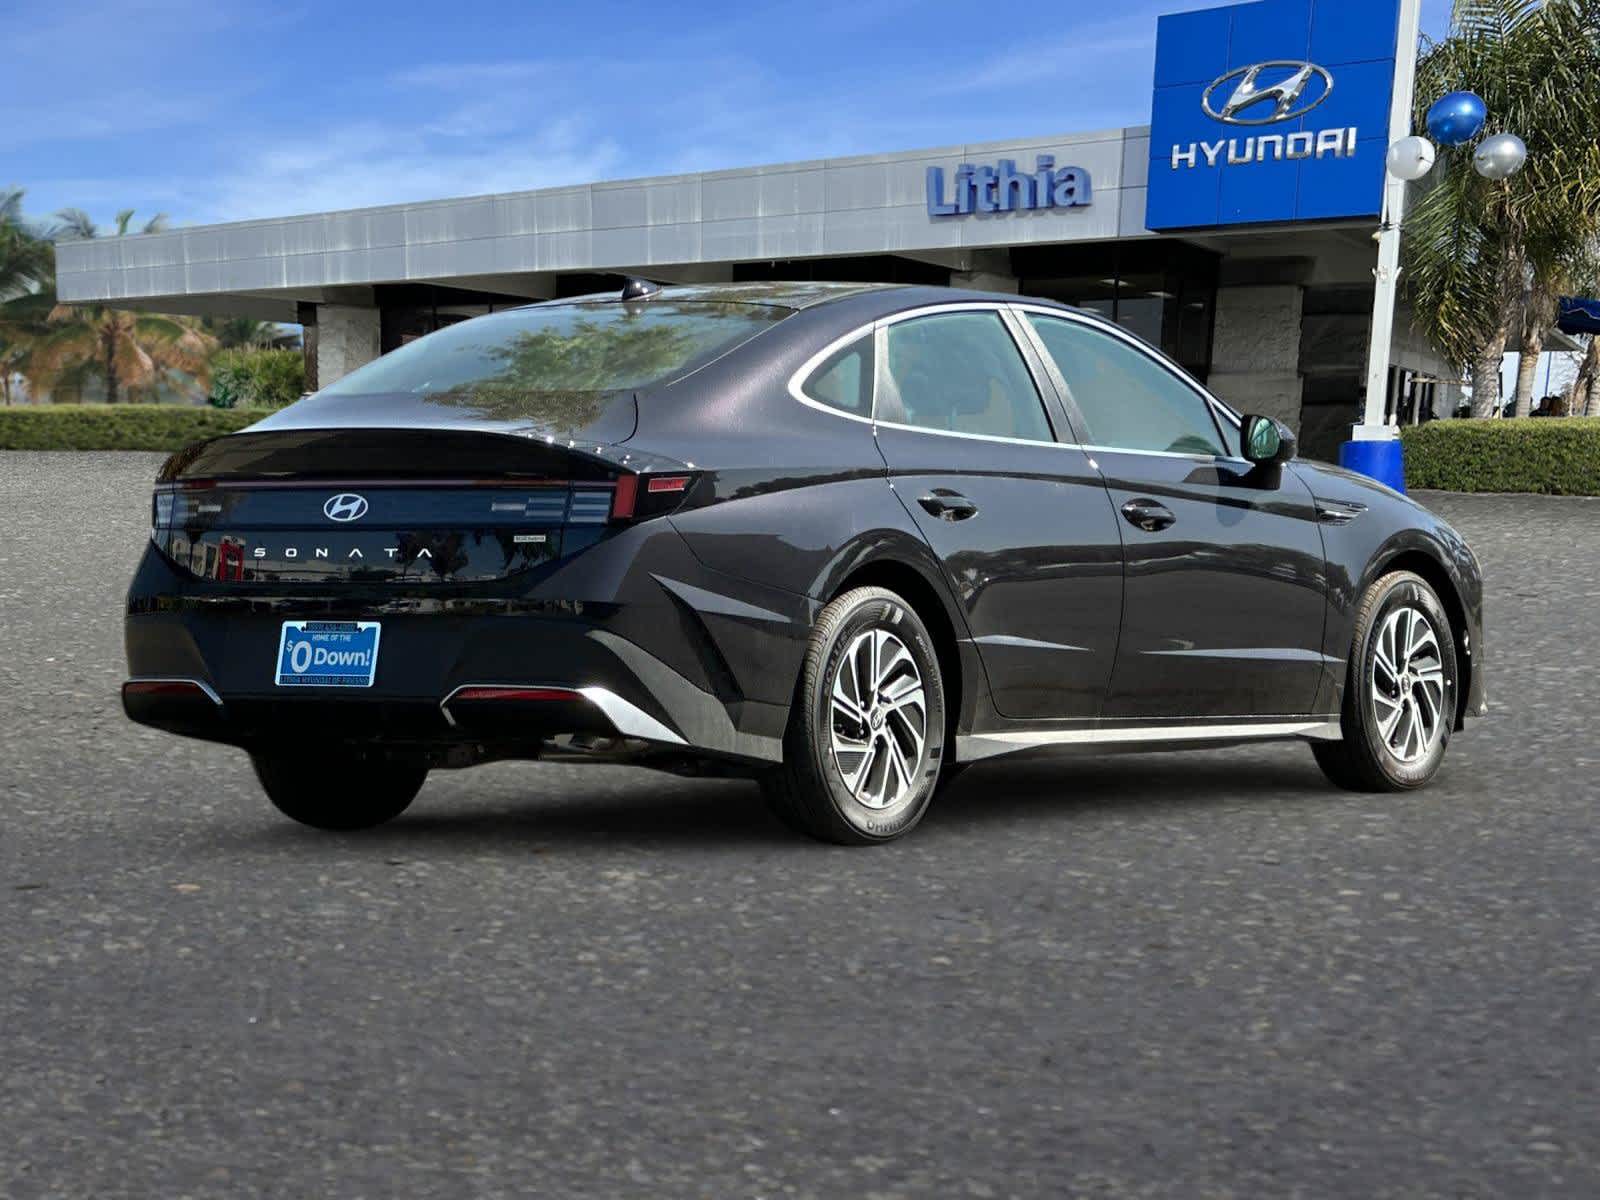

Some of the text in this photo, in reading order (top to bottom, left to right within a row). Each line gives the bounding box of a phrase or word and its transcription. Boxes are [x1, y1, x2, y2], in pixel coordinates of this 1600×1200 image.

[1171, 127, 1357, 169] HYUNDAI
[926, 155, 1092, 217] Lithia
[254, 548, 432, 558] SONATA
[314, 647, 371, 666] Down!
